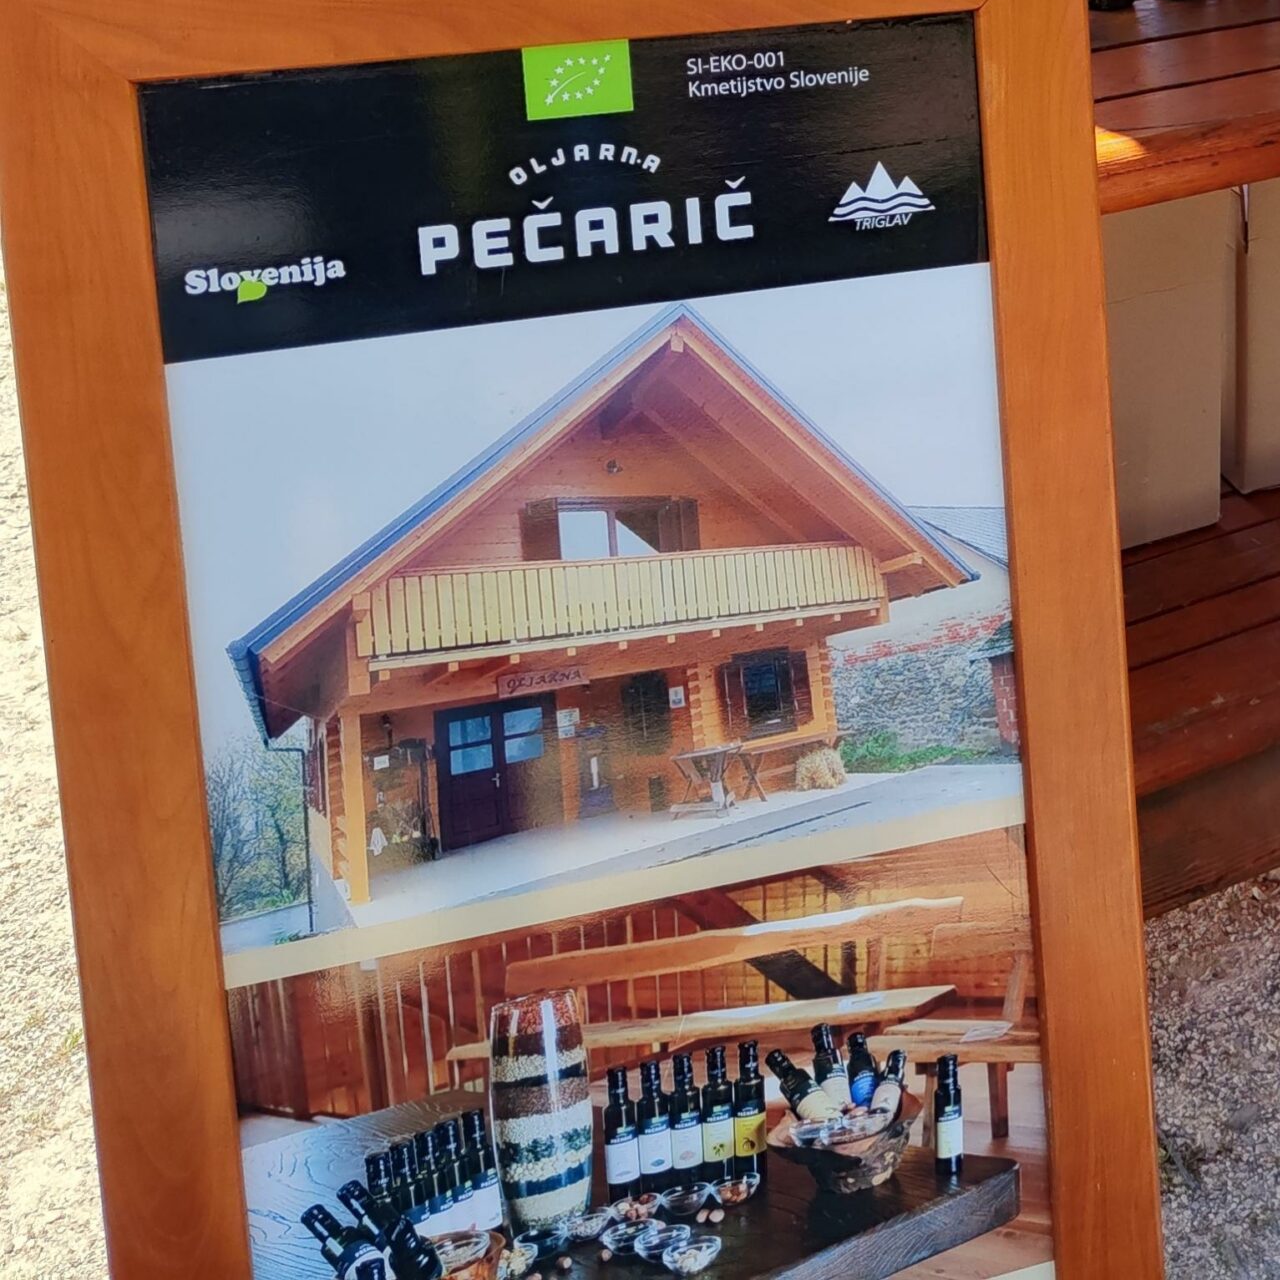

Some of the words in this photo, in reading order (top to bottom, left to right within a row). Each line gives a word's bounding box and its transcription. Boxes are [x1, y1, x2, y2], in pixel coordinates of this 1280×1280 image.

[686, 51, 785, 75] SI-EKO-001
[688, 74, 785, 98] Kmetijstvo
[789, 66, 870, 88] Slovenije
[417, 175, 755, 276] PEČARIČ
[854, 213, 913, 231] TRIGLAV
[184, 256, 346, 295] Slovenija
